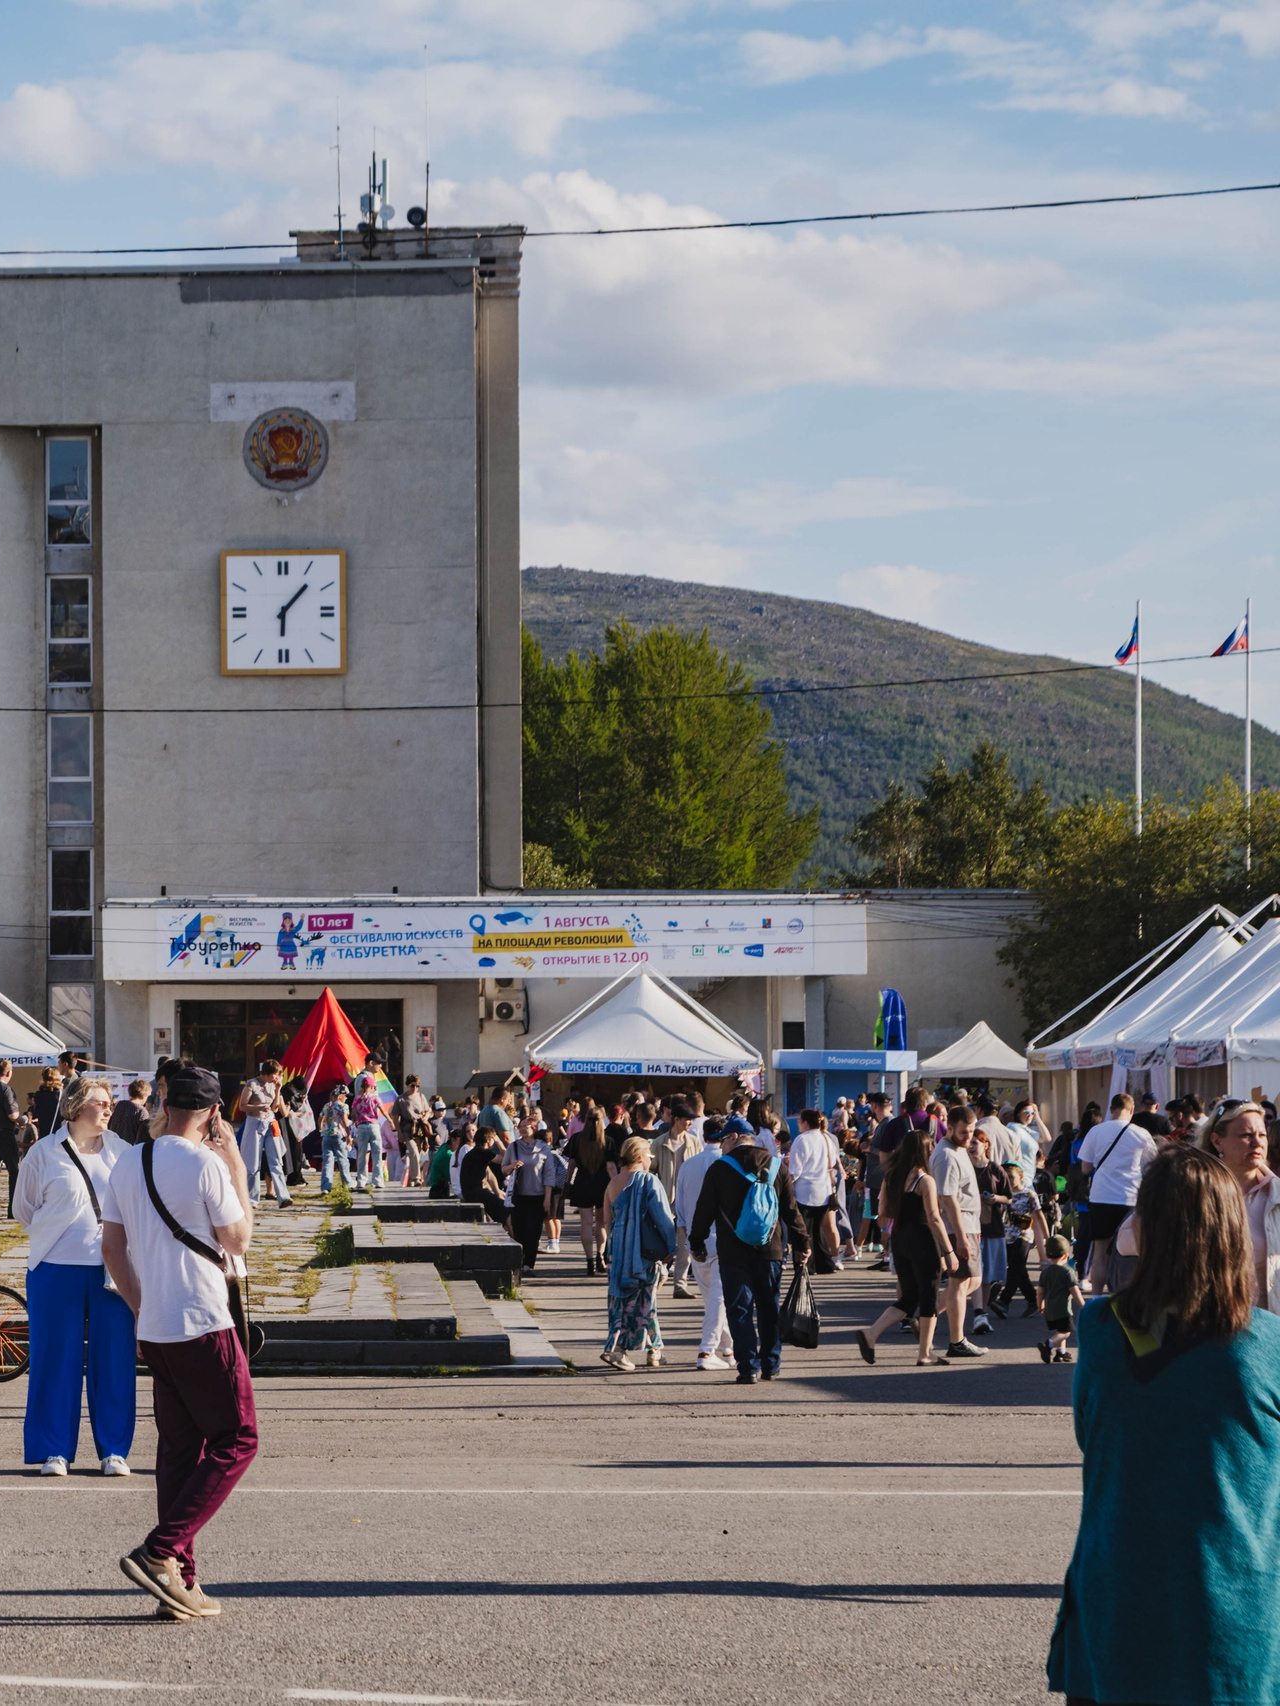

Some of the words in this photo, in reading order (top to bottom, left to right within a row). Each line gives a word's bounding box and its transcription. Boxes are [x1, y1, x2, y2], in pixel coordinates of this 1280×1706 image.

[311, 917, 325, 928] 10
[327, 918, 349, 928] лет
[544, 916, 550, 928] 1
[554, 915, 610, 928] АВГУСТА
[329, 931, 403, 945] ФЕСТИВАЛЮ
[405, 929, 464, 941] ИСКУССТВ
[478, 938, 493, 948] НА
[495, 936, 552, 948] ПЛОЩАДИ
[554, 934, 624, 946] РЕВОЛЮЦИИ
[170, 937, 262, 956] Табуретка
[331, 944, 423, 960] «ТАБУРЕТКА»
[542, 955, 601, 966] ОТКРЫТИЕ
[604, 954, 611, 964] В
[613, 951, 649, 963] 12.00
[827, 1056, 882, 1066] Мончегорск
[566, 1062, 638, 1073] МОНЧЕГОРСК
[647, 1064, 661, 1073] НА
[663, 1064, 724, 1075] ТАБУРЕТКЕ
